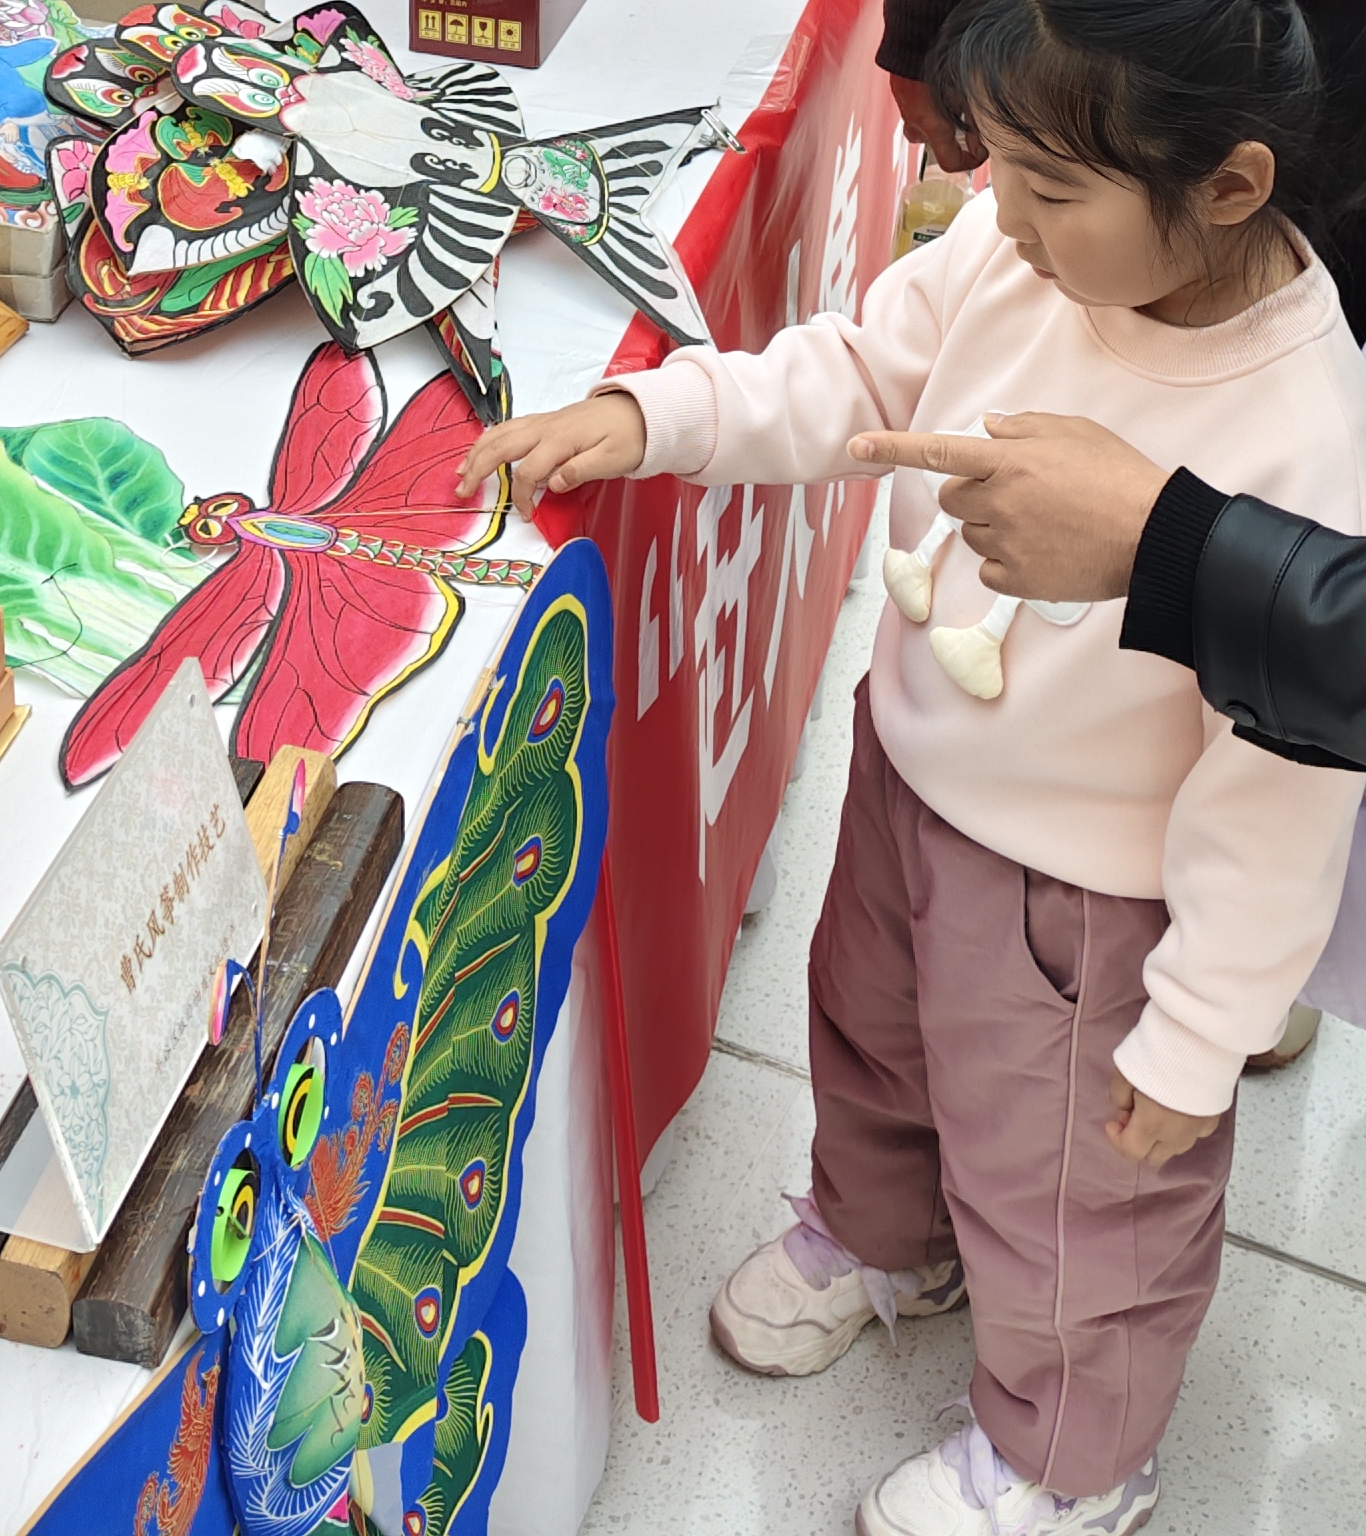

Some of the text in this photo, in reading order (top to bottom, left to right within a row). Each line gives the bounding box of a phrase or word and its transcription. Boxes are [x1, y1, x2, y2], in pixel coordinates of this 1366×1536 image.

[120, 802, 226, 994] 曹氏风筝制作技艺
